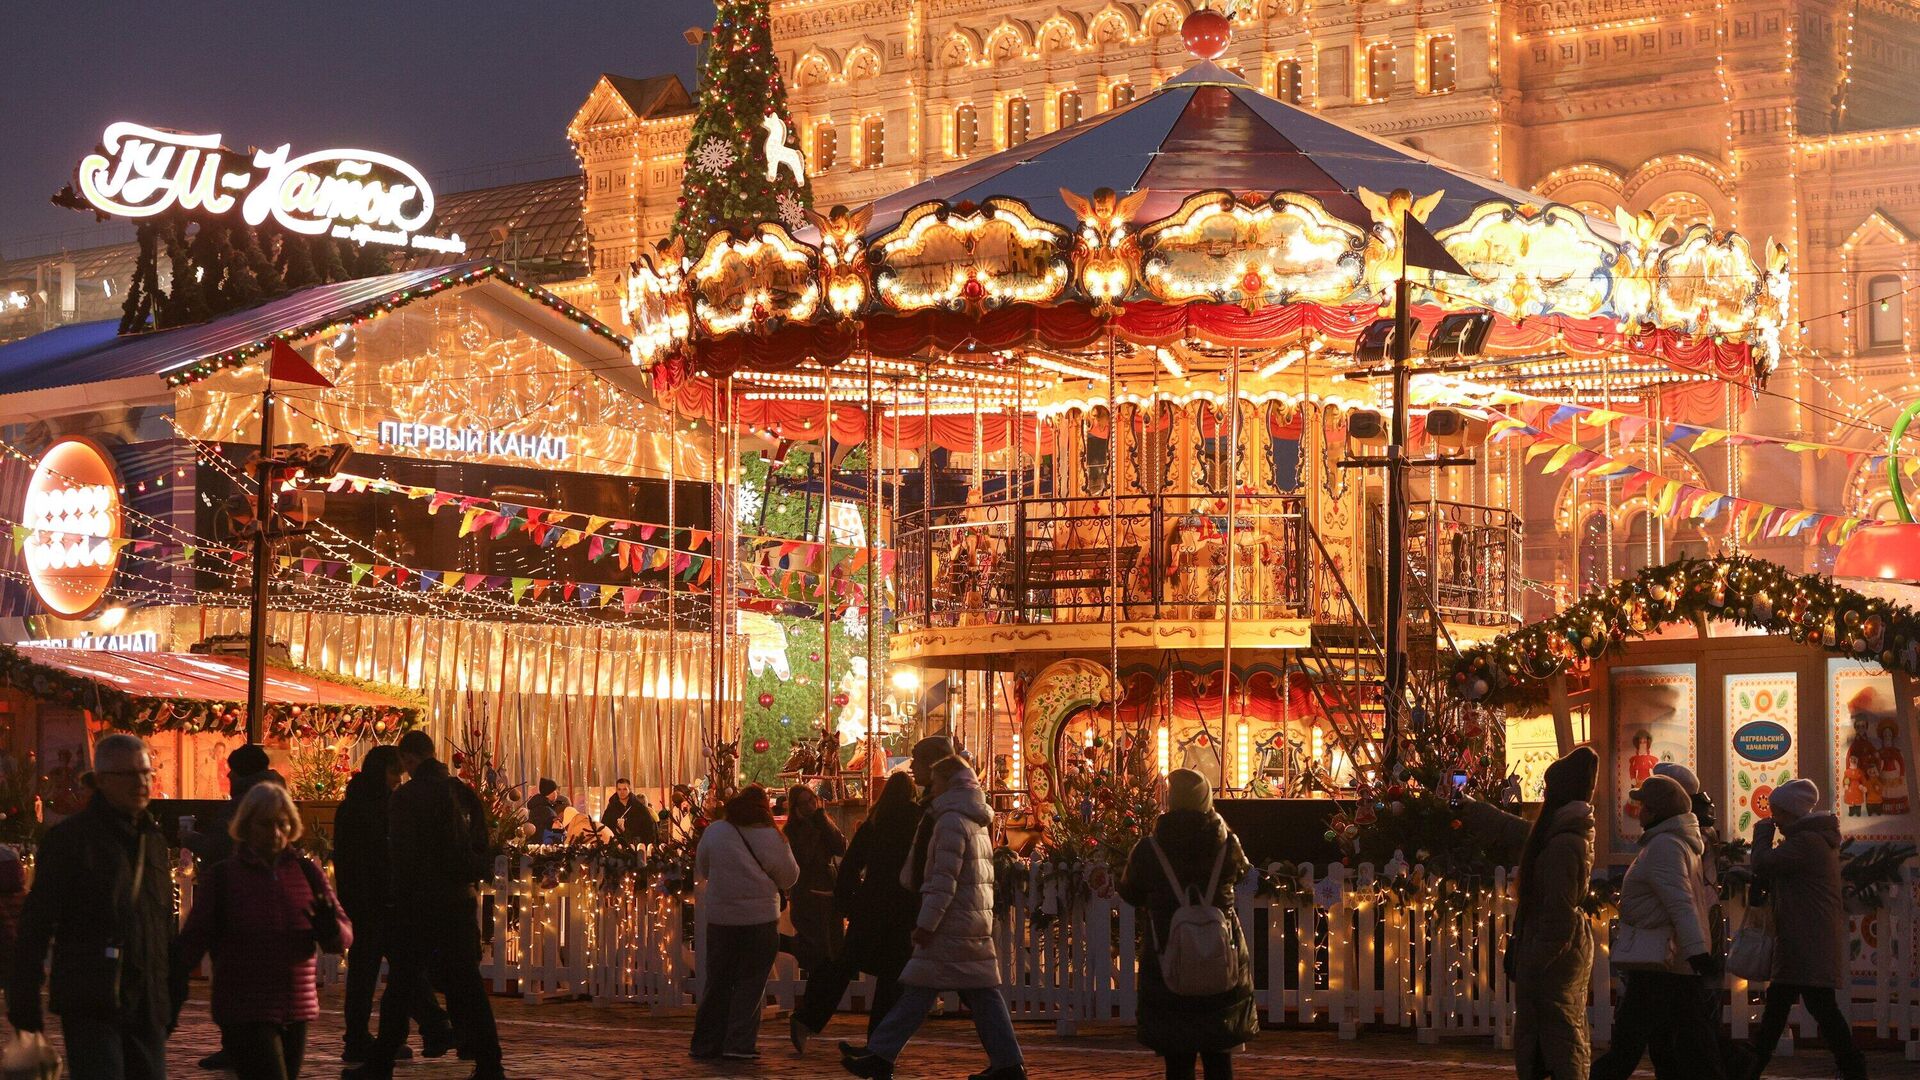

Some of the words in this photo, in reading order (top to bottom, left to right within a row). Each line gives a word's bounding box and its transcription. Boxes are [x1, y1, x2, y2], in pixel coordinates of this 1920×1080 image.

[380, 421, 482, 454] ПЕРВЫЙ
[488, 430, 567, 460] КАНАЛ
[95, 631, 157, 652] КАНАЛ
